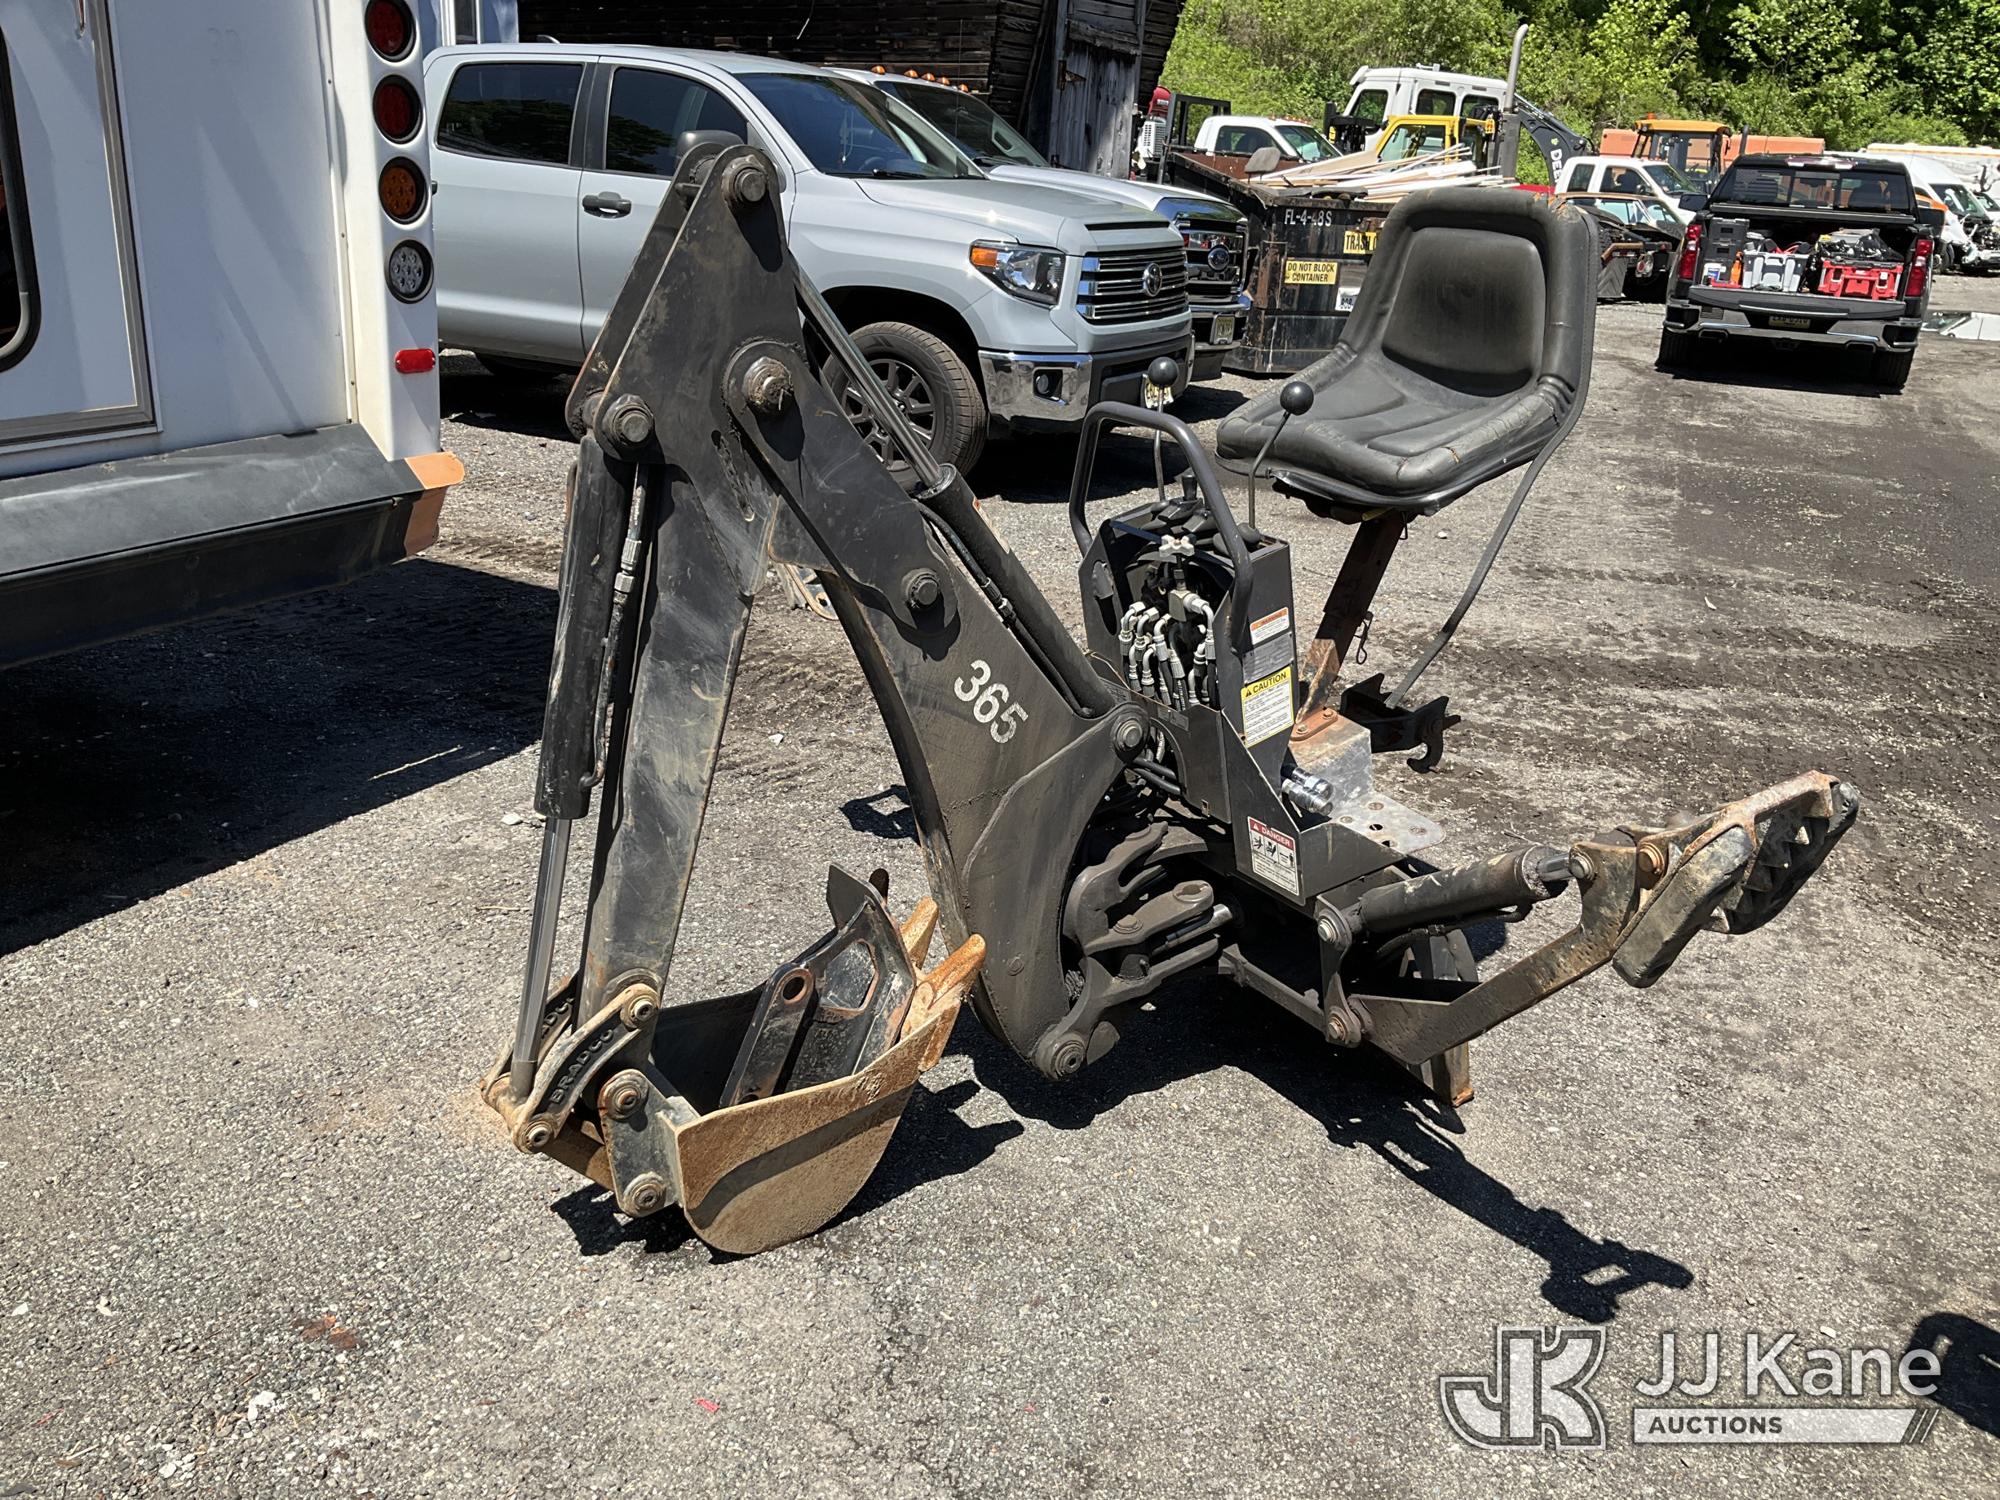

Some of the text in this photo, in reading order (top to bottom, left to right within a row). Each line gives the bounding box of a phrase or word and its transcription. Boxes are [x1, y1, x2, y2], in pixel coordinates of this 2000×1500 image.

[1550, 148, 1563, 184] DEE
[1287, 262, 1335, 273] DO NOT BLOCK
[1292, 272, 1329, 282] CONTAINER
[1252, 671, 1288, 695] CAUTION
[954, 659, 1029, 744] 365
[1261, 826, 1291, 846] DANGER
[550, 1028, 614, 1103] BRADCO
